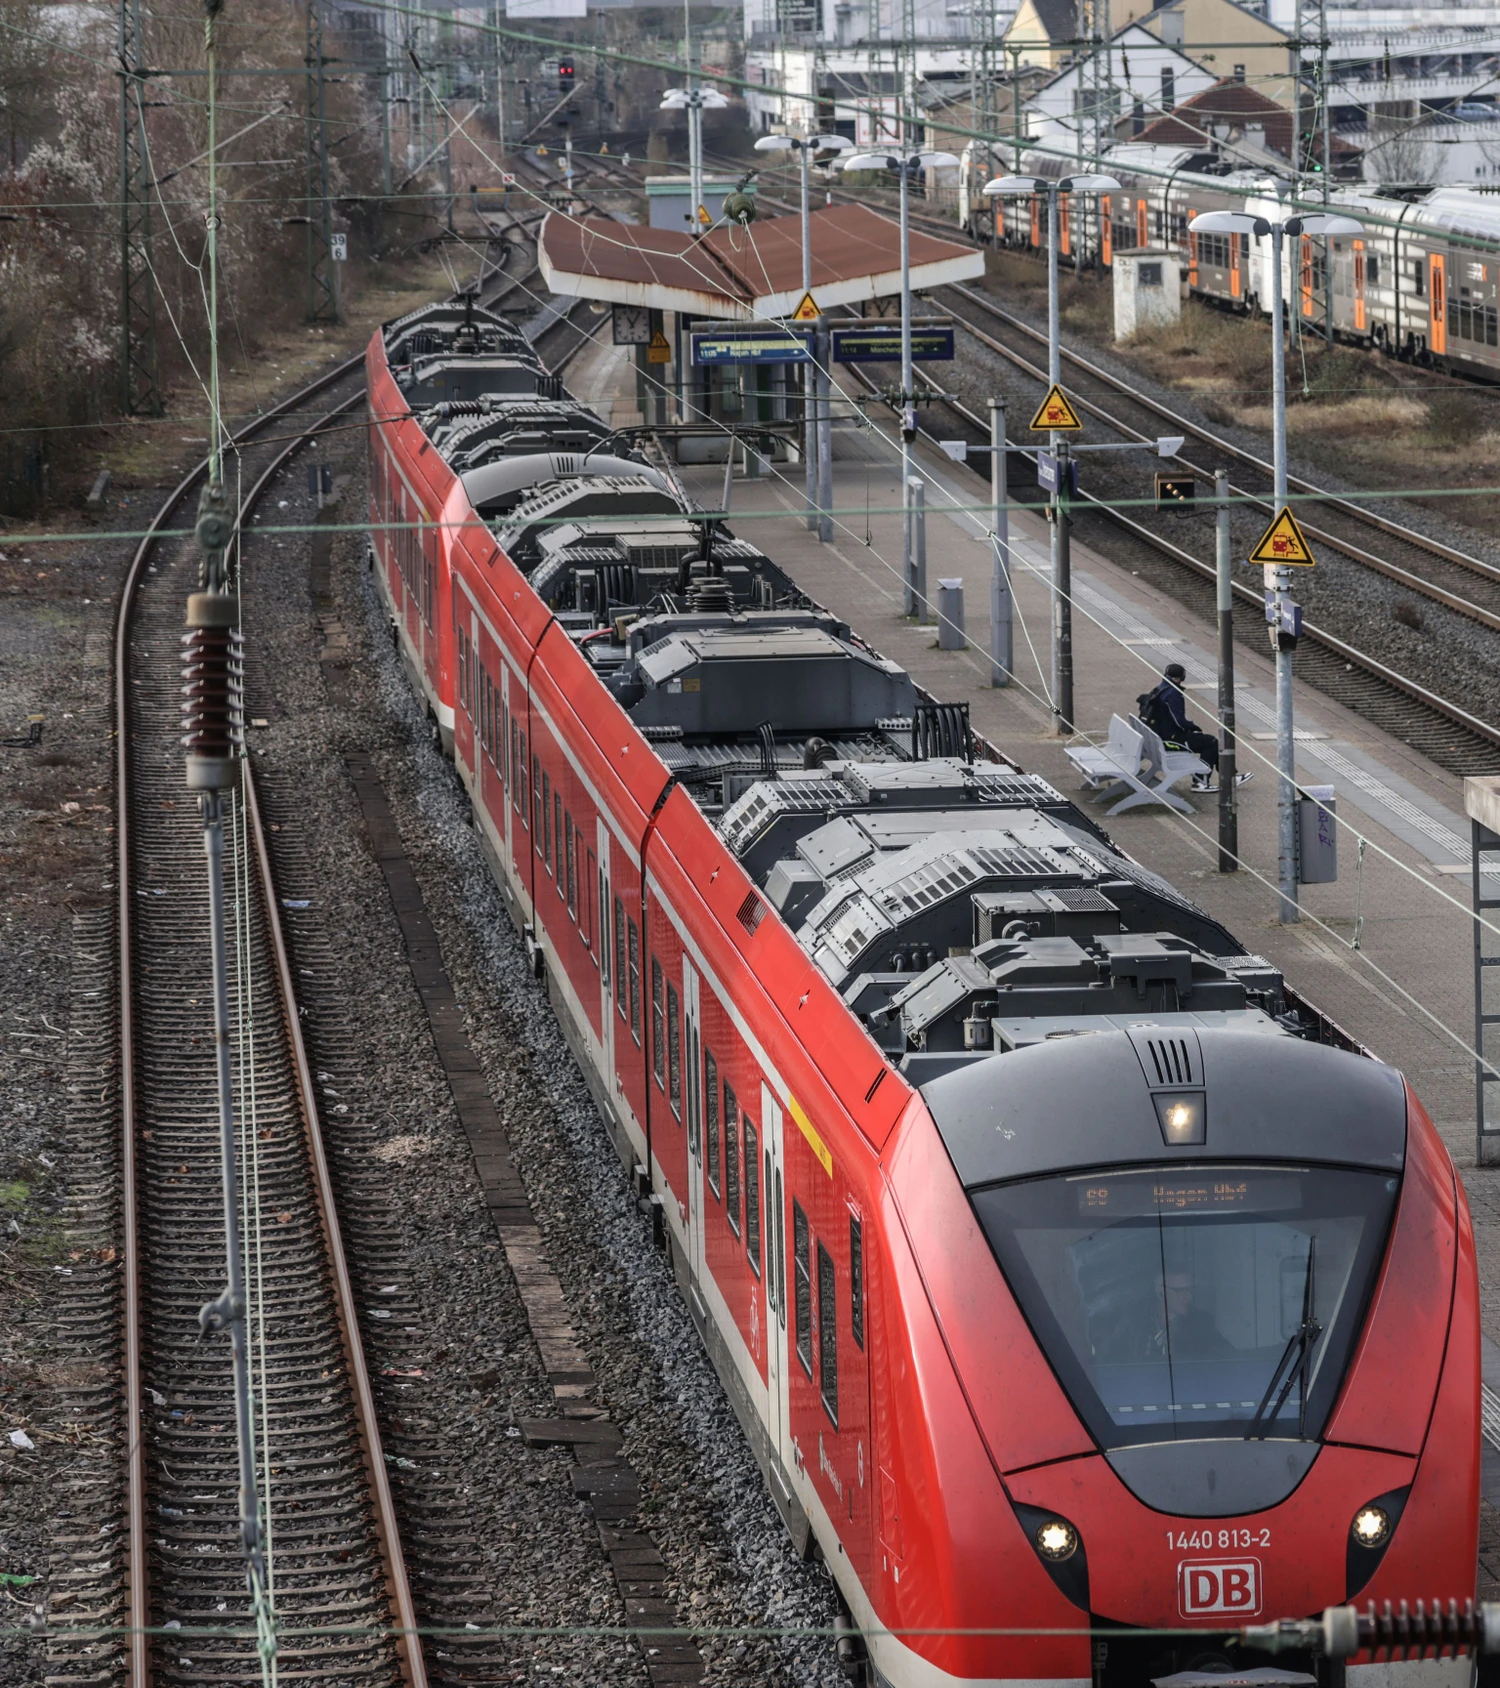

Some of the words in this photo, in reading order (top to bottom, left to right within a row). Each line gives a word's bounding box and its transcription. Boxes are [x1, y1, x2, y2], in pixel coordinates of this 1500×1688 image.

[1166, 1530, 1213, 1550] 1440
[1217, 1528, 1271, 1549] 813-2
[1187, 1567, 1253, 1610] DB
